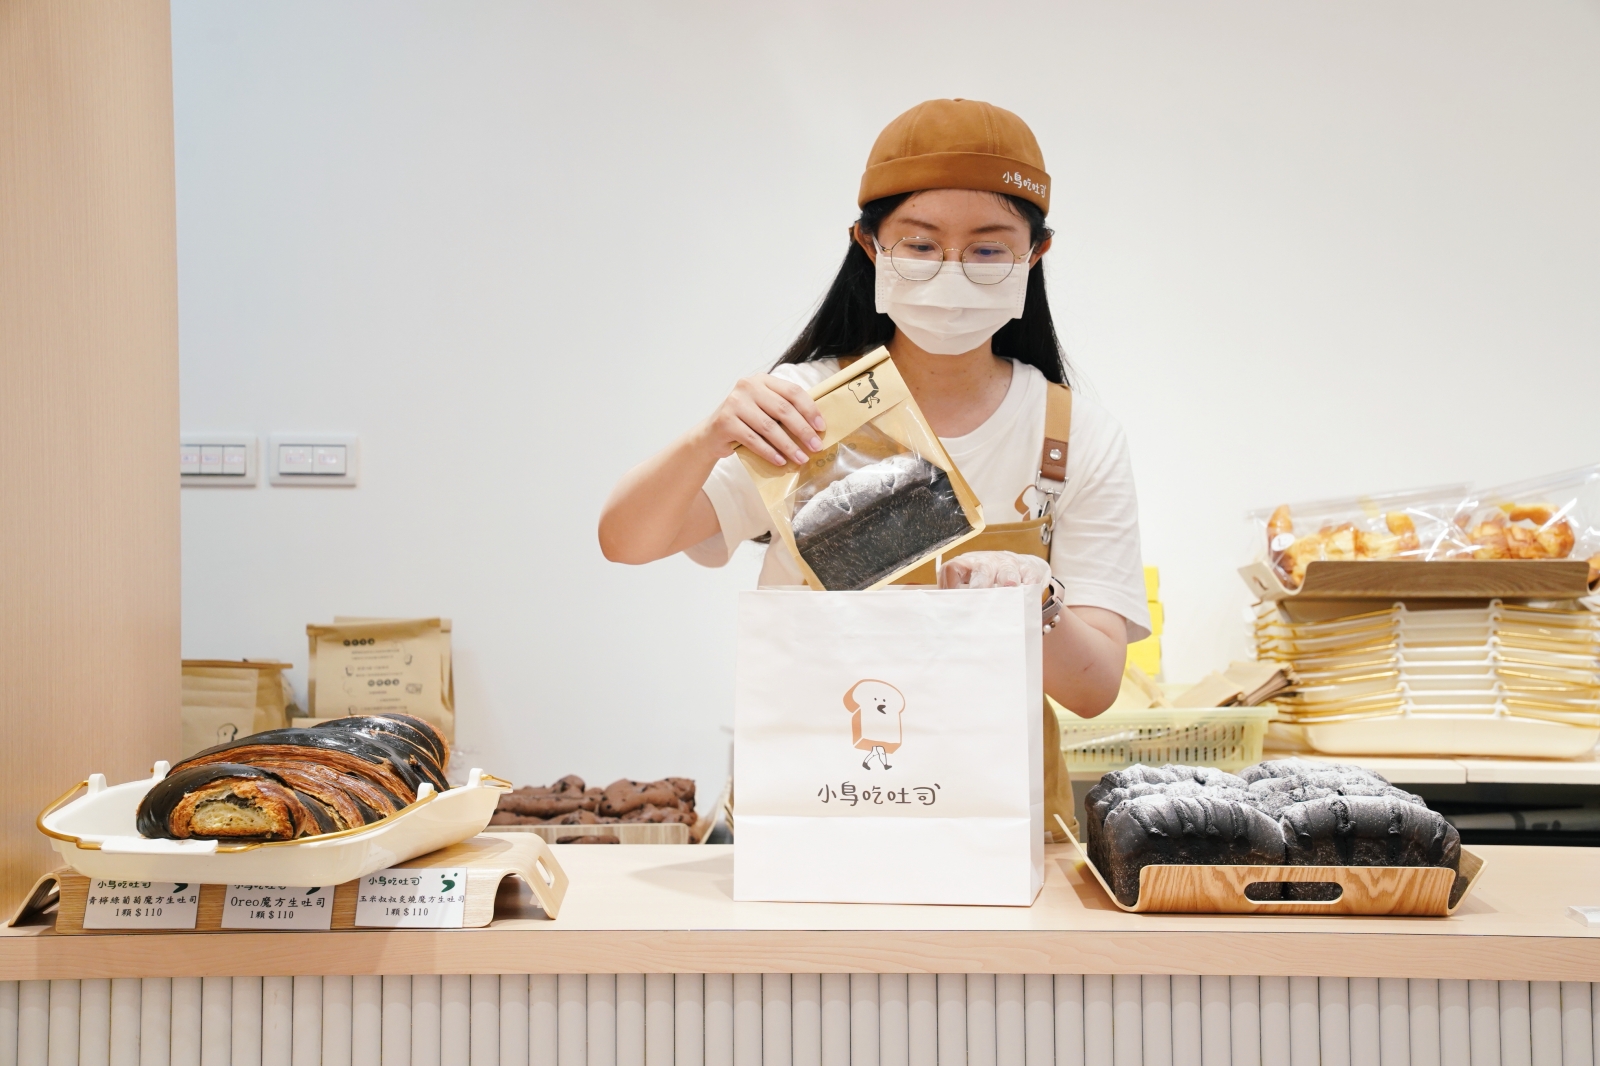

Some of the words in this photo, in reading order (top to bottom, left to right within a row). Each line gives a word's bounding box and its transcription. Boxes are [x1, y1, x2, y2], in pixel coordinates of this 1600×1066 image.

[89, 895, 197, 905] 青檸綠葡萄魔方生吐司
[230, 896, 326, 908] Oreo魔方生吐司
